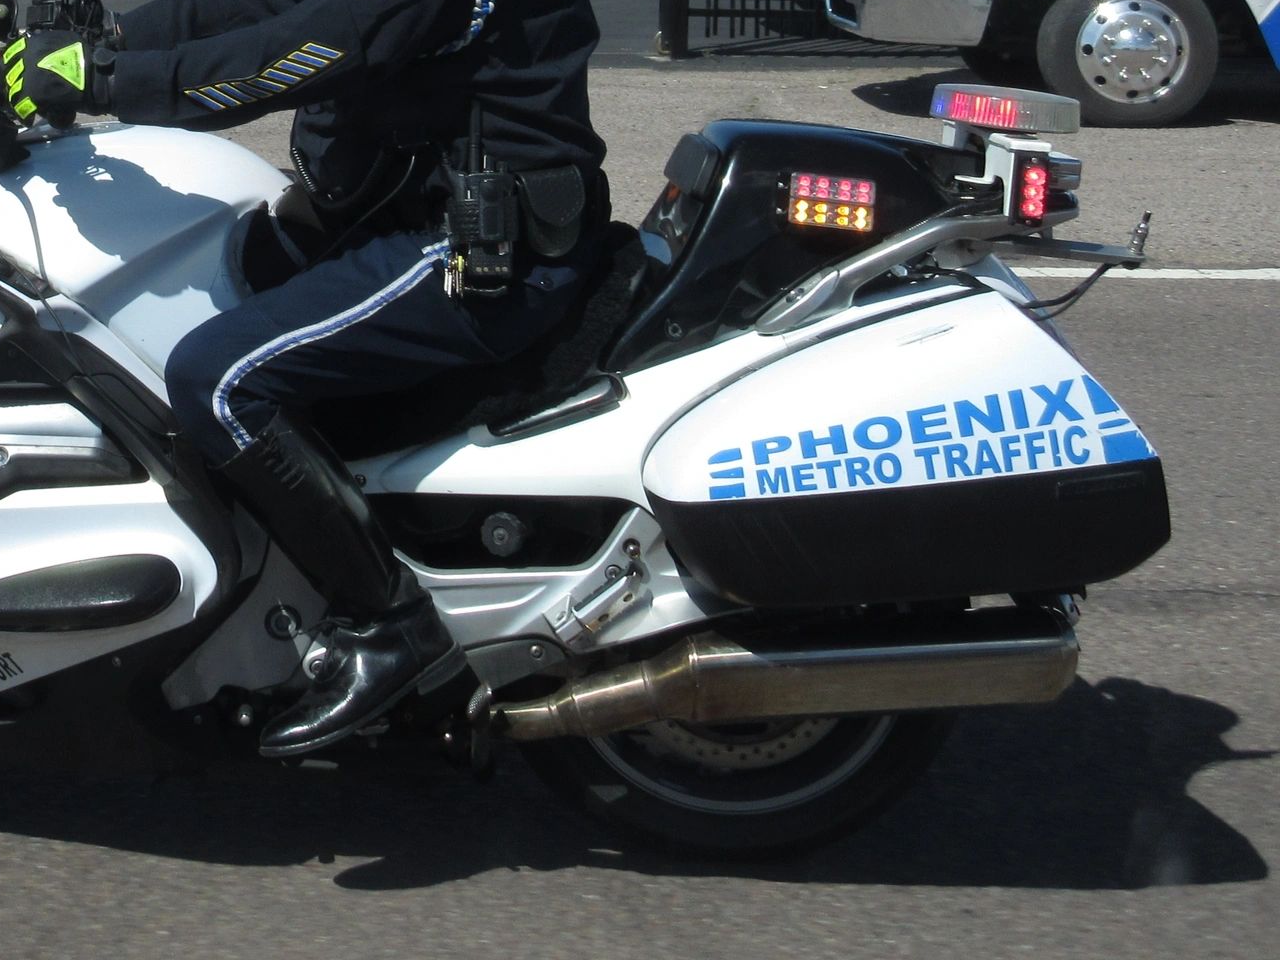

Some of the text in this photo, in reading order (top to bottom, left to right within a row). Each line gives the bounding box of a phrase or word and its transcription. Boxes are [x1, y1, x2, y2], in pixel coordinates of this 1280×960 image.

[751, 378, 1084, 466] PHOENIX
[756, 425, 1090, 496] METRO TRAFFIC
